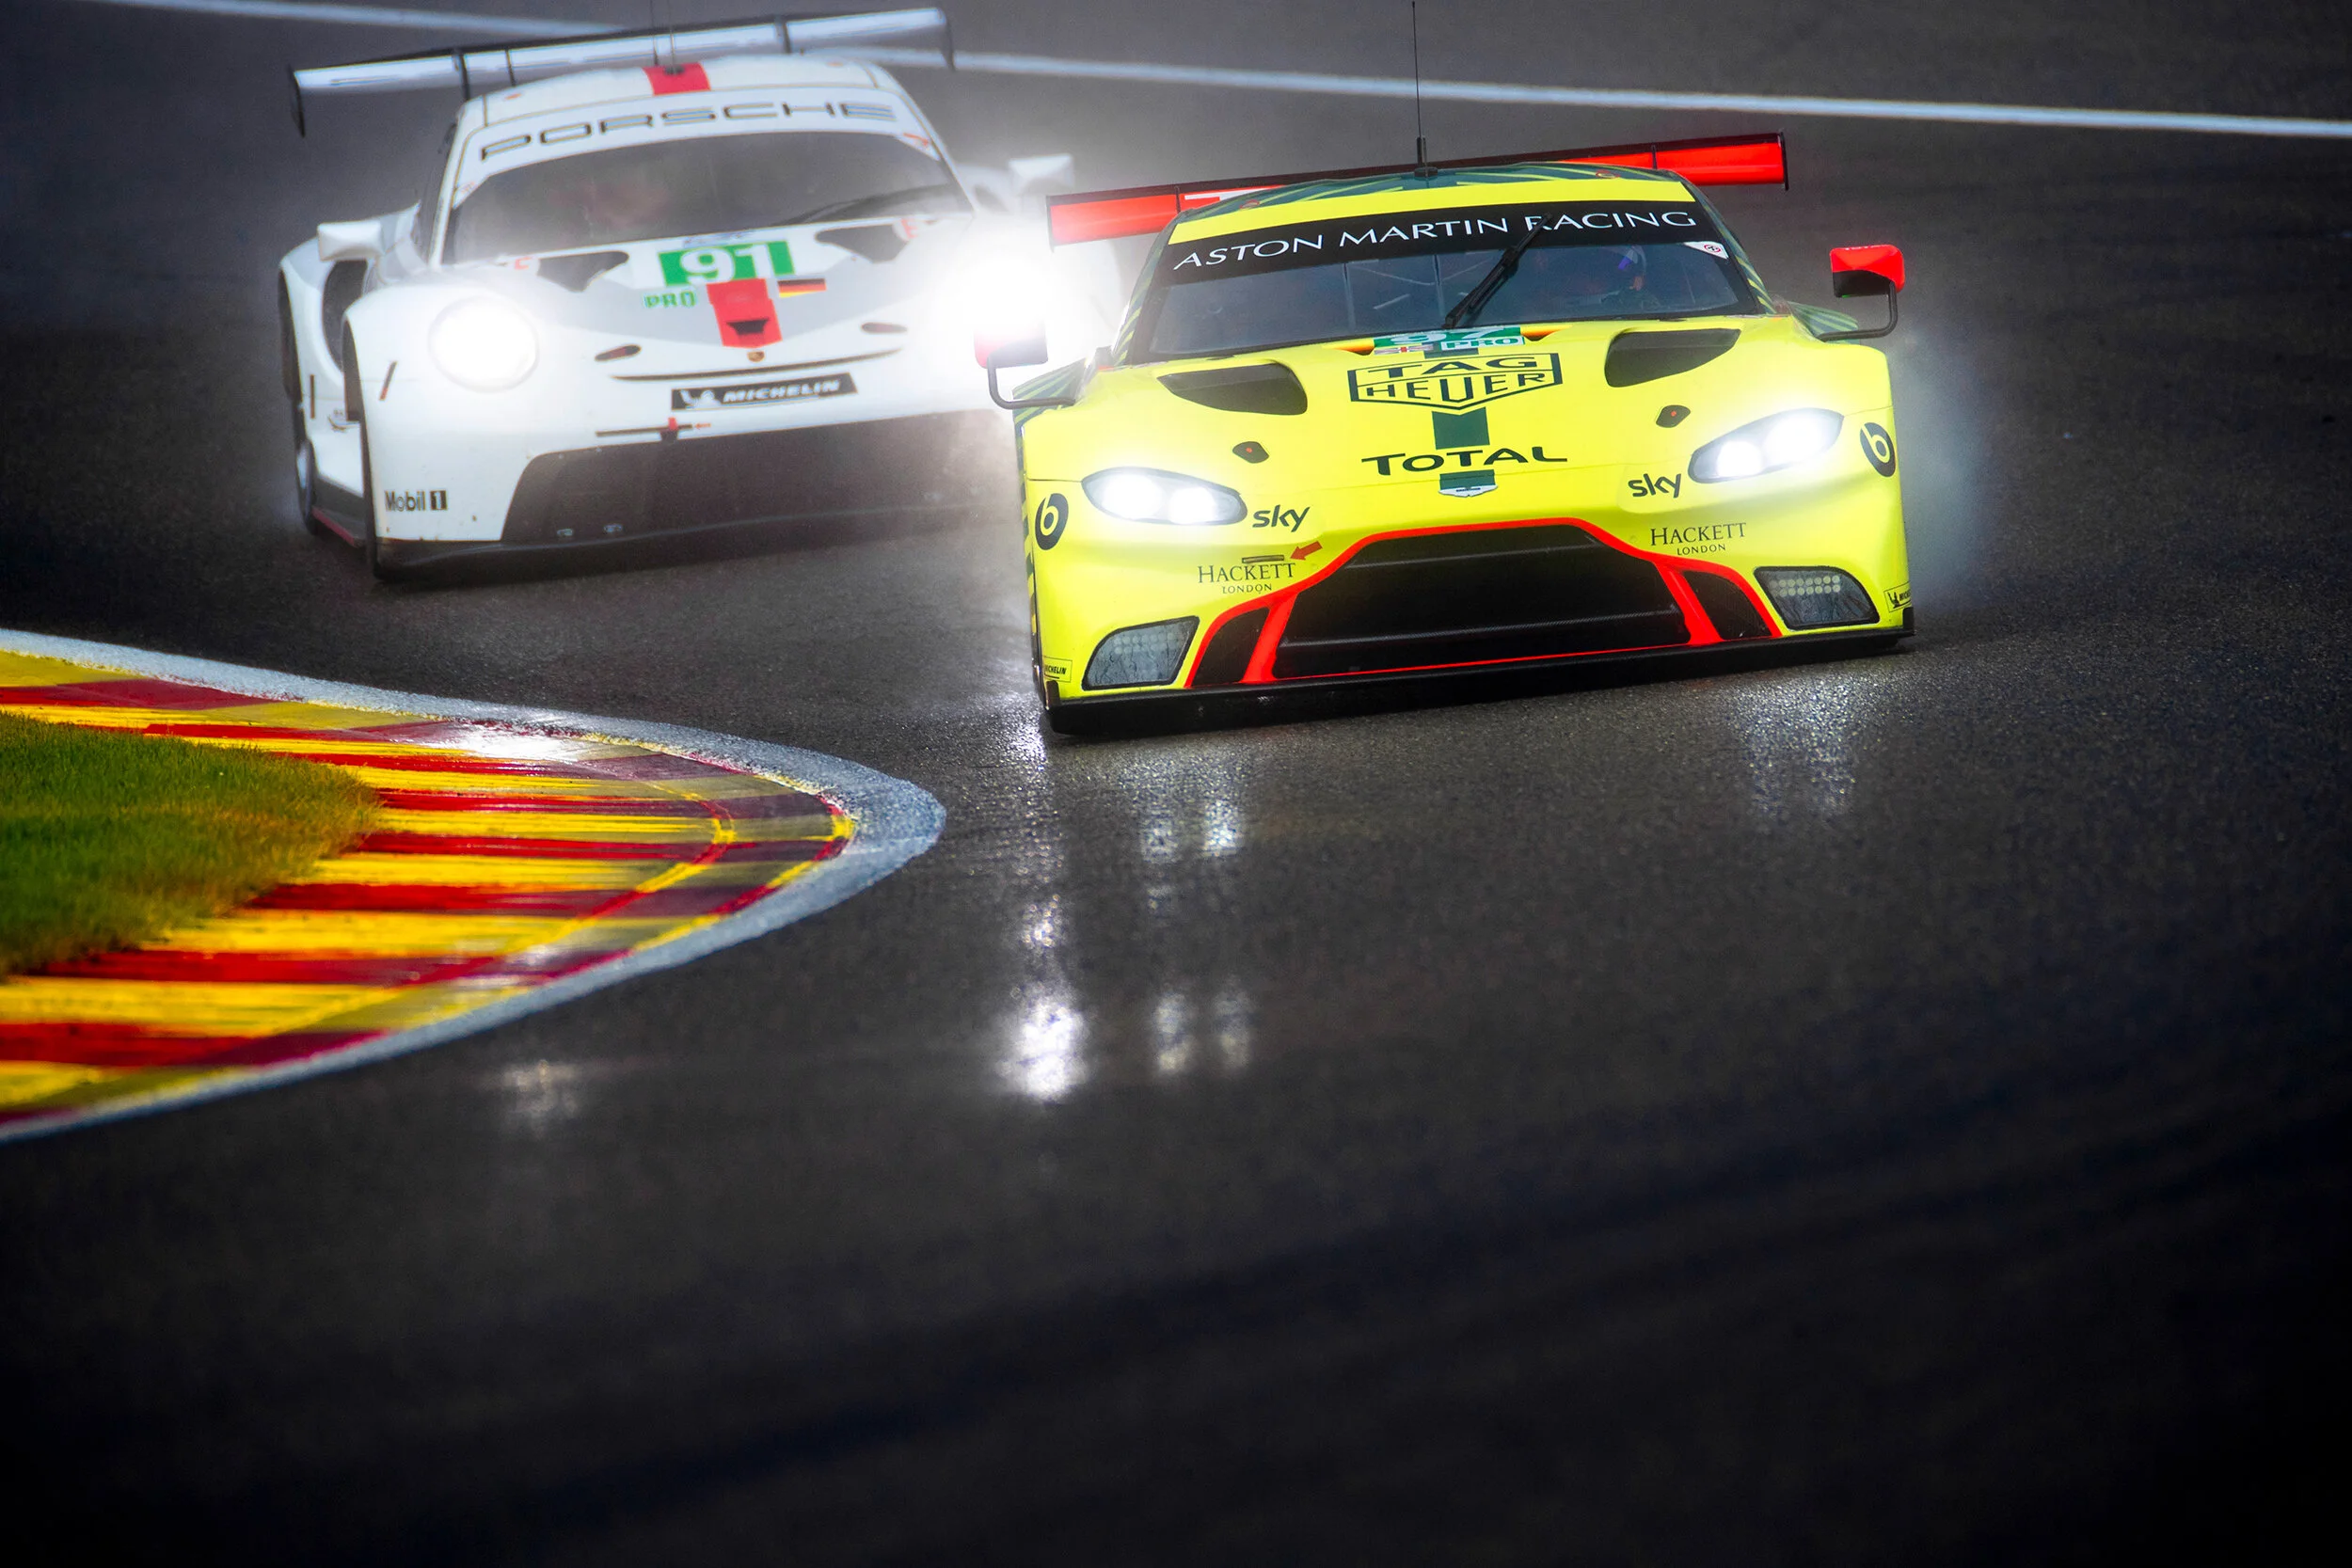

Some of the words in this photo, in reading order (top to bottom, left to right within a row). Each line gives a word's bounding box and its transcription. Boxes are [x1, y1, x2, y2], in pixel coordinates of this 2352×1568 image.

[481, 103, 897, 162] PORSCHE
[1173, 234, 1324, 271] ASTON
[1339, 217, 1508, 247] MARTIN
[1525, 212, 1695, 231] RACING
[679, 244, 776, 286] 91
[645, 291, 695, 308] PRO
[1445, 337, 1520, 349] PRO
[1368, 356, 1538, 378] TAG
[723, 380, 840, 404] MICHELIN
[1366, 372, 1546, 403] HEUER
[1361, 446, 1568, 475] TOTAL
[1628, 473, 1681, 499] sky
[385, 490, 426, 511] Mobil
[432, 490, 448, 511] 1
[1252, 504, 1311, 532] sky
[1650, 522, 1746, 546] HACKETT
[1677, 544, 1726, 556] LONDON
[1198, 562, 1295, 583] HACKETT
[1222, 583, 1272, 594] LONDON
